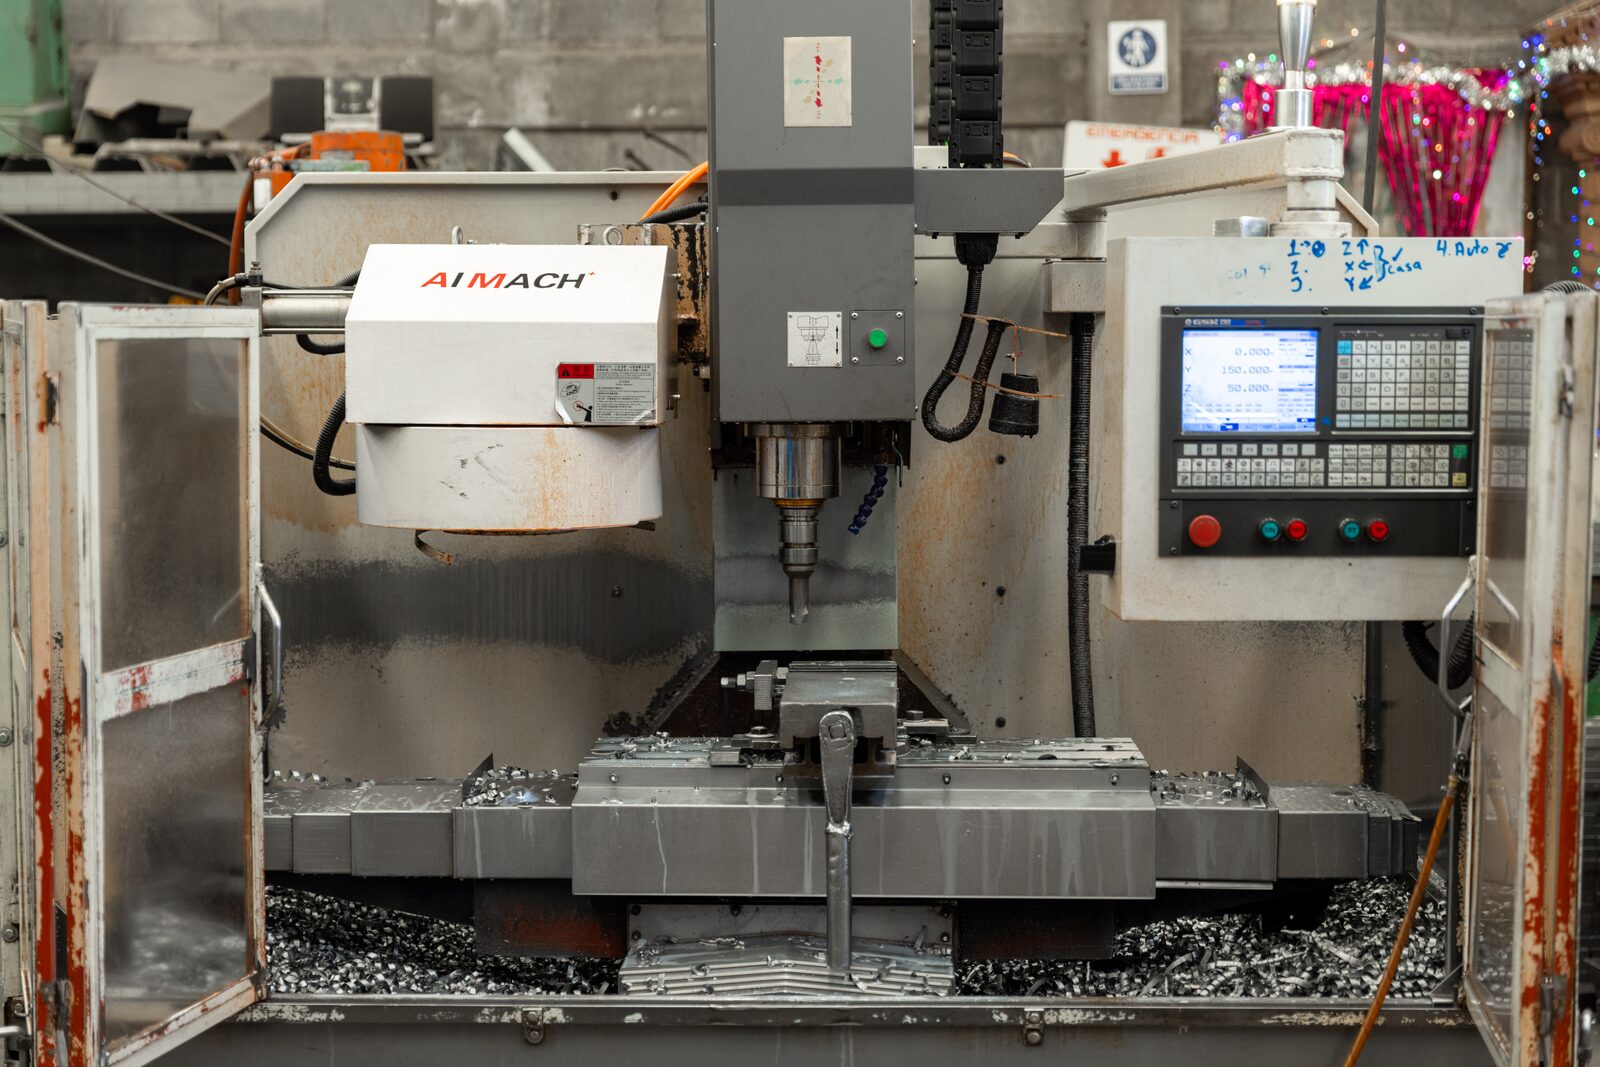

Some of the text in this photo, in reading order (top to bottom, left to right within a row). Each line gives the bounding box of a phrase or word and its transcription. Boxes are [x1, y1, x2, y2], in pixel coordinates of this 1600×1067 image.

[1455, 239, 1489, 256] Auto
[1235, 347, 1270, 356] 0.000
[1221, 366, 1270, 374] 150.000
[1227, 384, 1270, 393] 50.000
